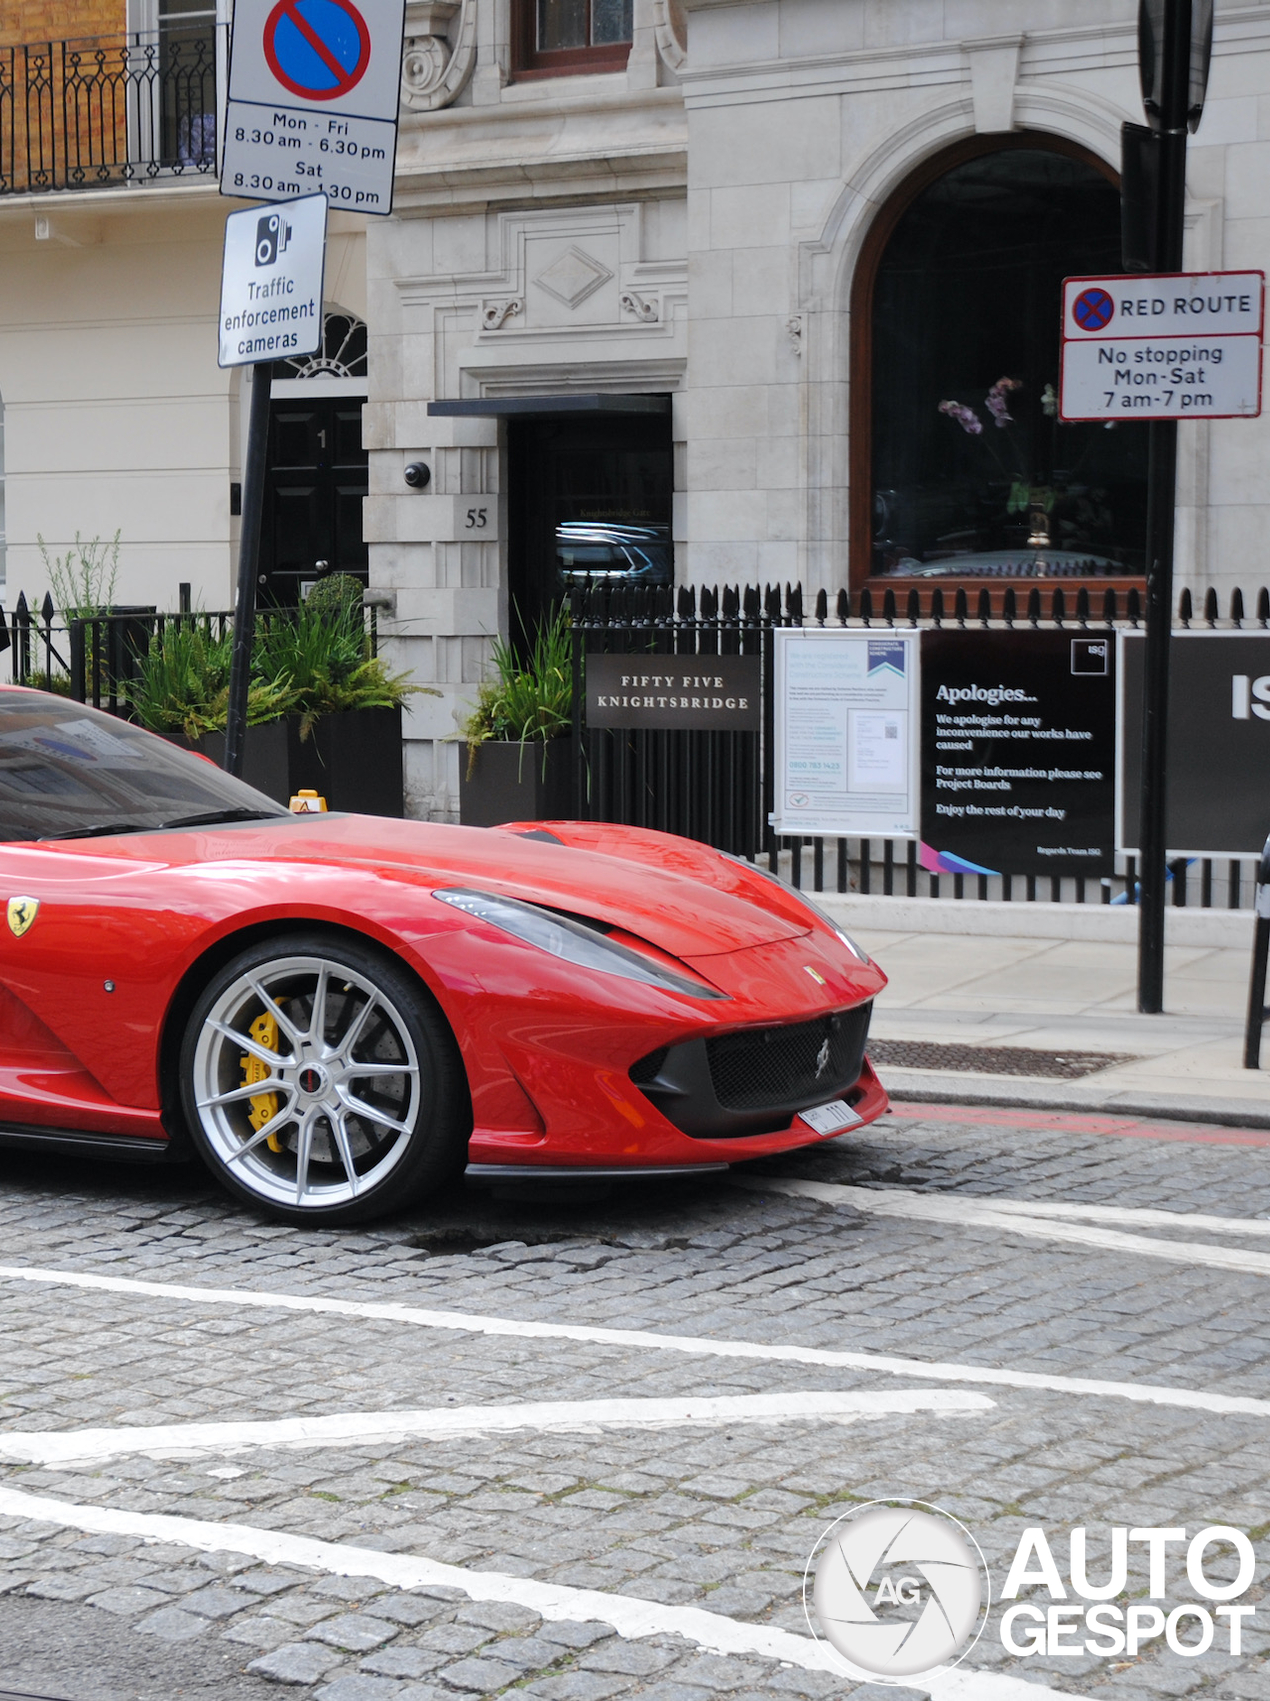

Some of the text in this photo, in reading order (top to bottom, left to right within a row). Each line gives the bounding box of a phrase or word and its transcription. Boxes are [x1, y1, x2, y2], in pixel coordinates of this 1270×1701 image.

[273, 113, 307, 131] Mon
[328, 119, 349, 135] Fri
[234, 128, 274, 145] 8.30
[278, 135, 301, 149] am
[319, 139, 358, 156] 6.30
[361, 145, 386, 160] pm
[295, 161, 323, 178] Sat
[234, 173, 273, 190] 8.30
[277, 181, 301, 194] am
[355, 191, 380, 204] pm
[247, 278, 294, 301] Traffic
[224, 299, 315, 331] enforcement
[1120, 295, 1251, 316] RED ROUTE
[237, 331, 298, 355] cameras
[1098, 345, 1223, 366] No stopping
[1181, 392, 1213, 410] pm
[316, 428, 326, 449] 1
[465, 507, 487, 529] 55
[621, 675, 724, 688] FIFTY FIVE
[597, 695, 749, 709] KNIGHTSBRIDGE
[936, 684, 1038, 705] Apologies...
[936, 714, 1041, 728] We apologise for any
[936, 727, 1092, 740] inconvenience our works have
[936, 740, 973, 751] caused
[936, 765, 1103, 781] For more information please see
[936, 779, 1012, 791] Project Boards
[936, 803, 1065, 821] Enjoy the rest of your day
